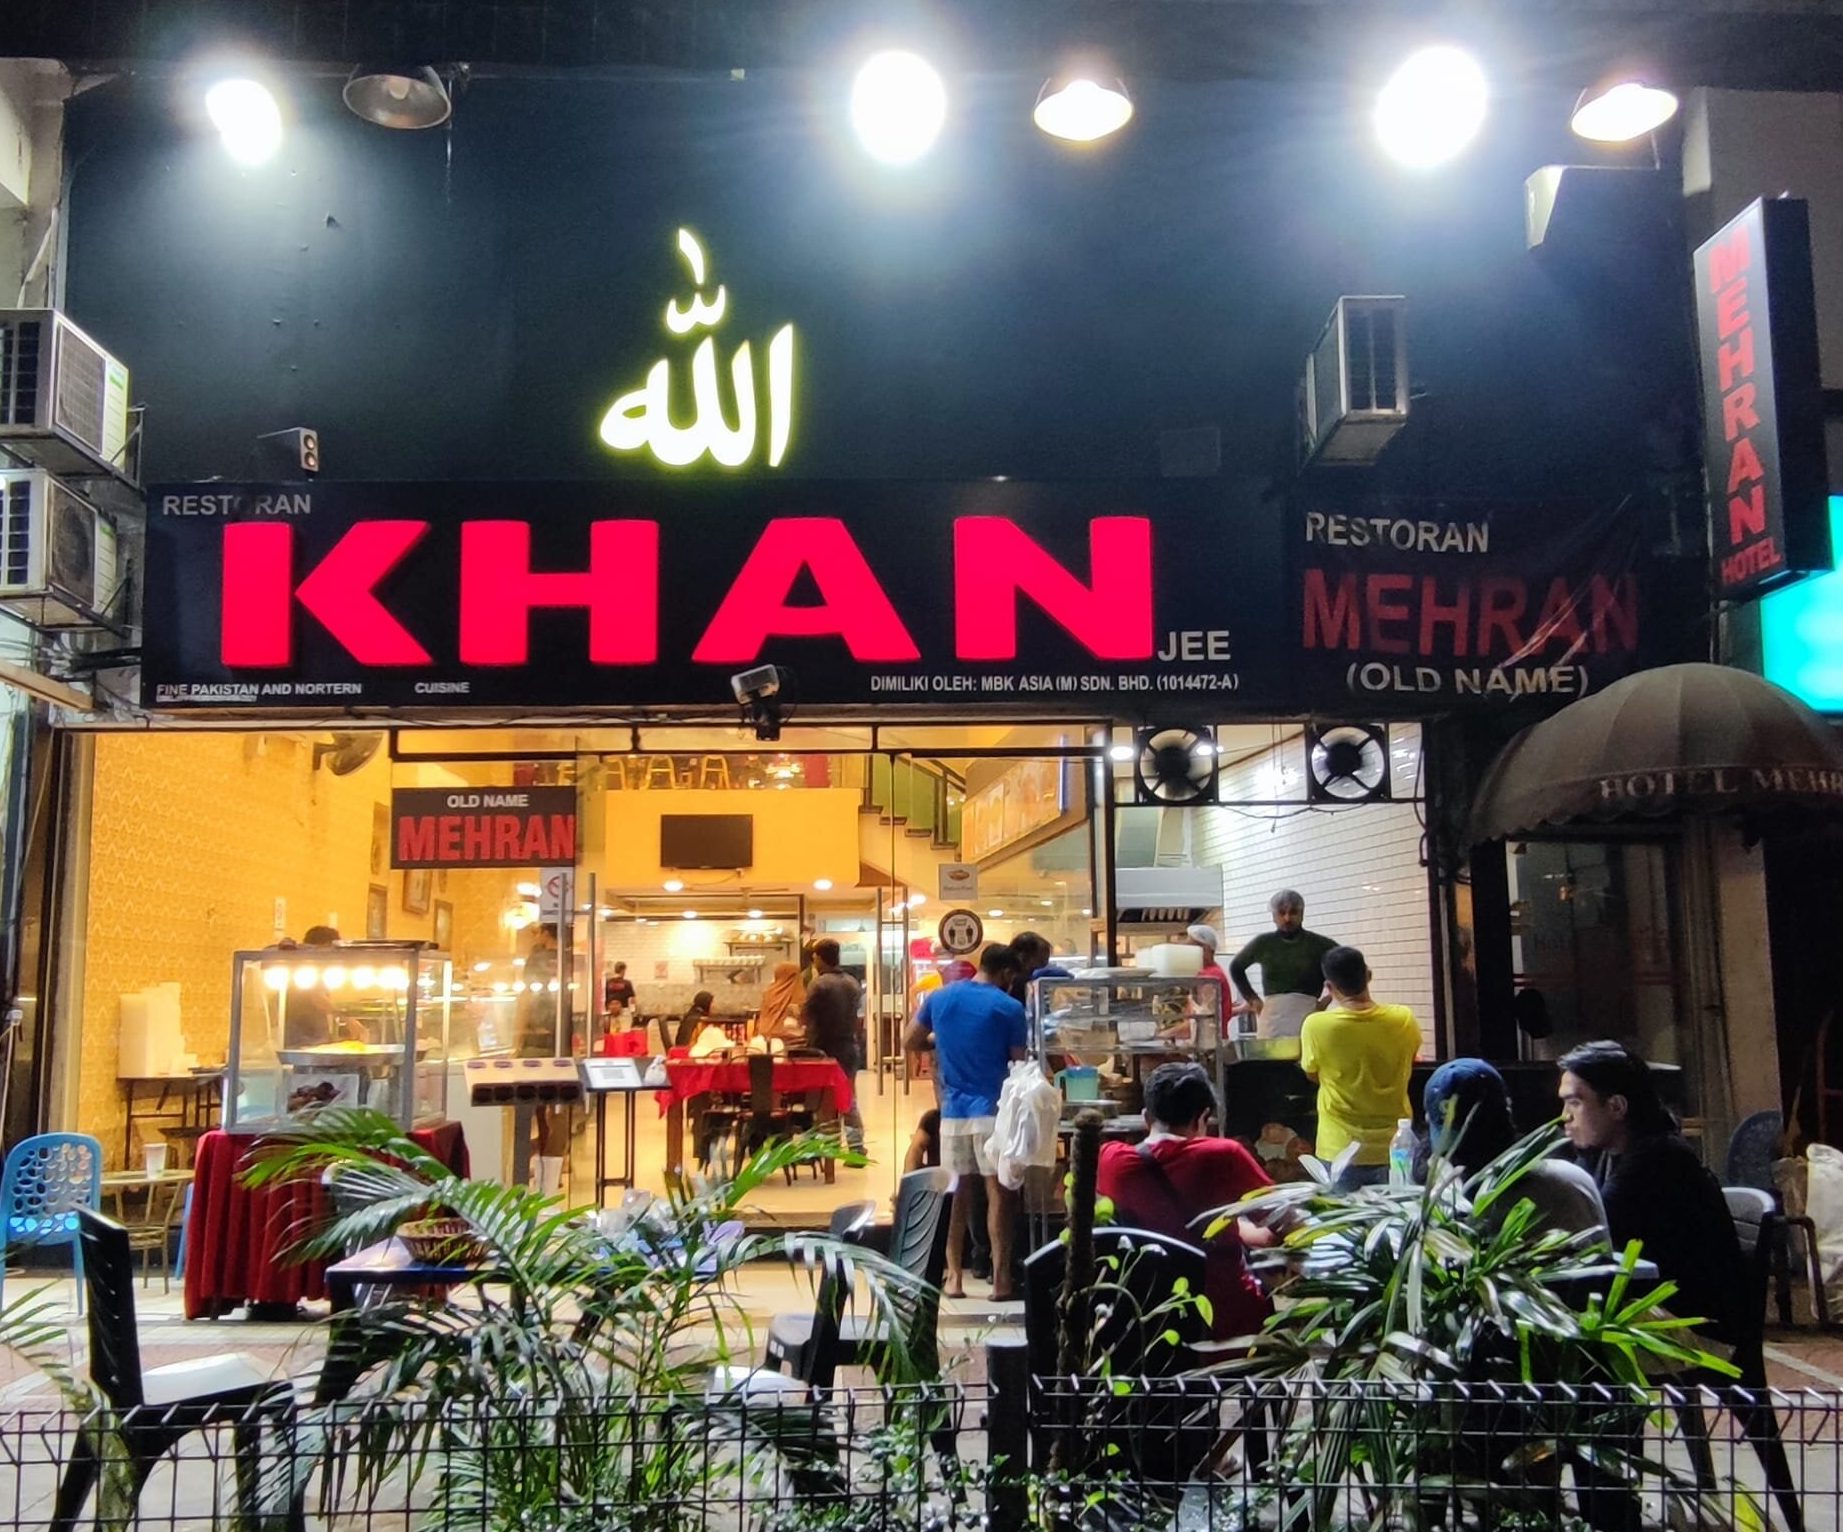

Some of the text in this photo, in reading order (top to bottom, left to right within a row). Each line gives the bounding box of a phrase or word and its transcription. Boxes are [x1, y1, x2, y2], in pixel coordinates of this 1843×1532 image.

[1709, 224, 1765, 545] MEHRAN
[162, 493, 312, 516] RESTRAN
[1306, 511, 1489, 553] RESTORAN
[1721, 537, 1782, 586] HOTEL
[221, 516, 1154, 666] KHAN
[1303, 568, 1640, 656] MEHRAN
[1157, 630, 1231, 661] JEE
[156, 683, 362, 696] FINE PAKISTAN AND NORTERN
[414, 682, 470, 694] CUISINE
[871, 673, 1239, 692] DIMILIKI OLEH: MBK ASIA (M) SDN. BHD. (1014472-A)
[1346, 662, 1589, 697] (OLD NAME)
[447, 794, 528, 808] OLD NAME
[399, 814, 577, 861] MEHRAN
